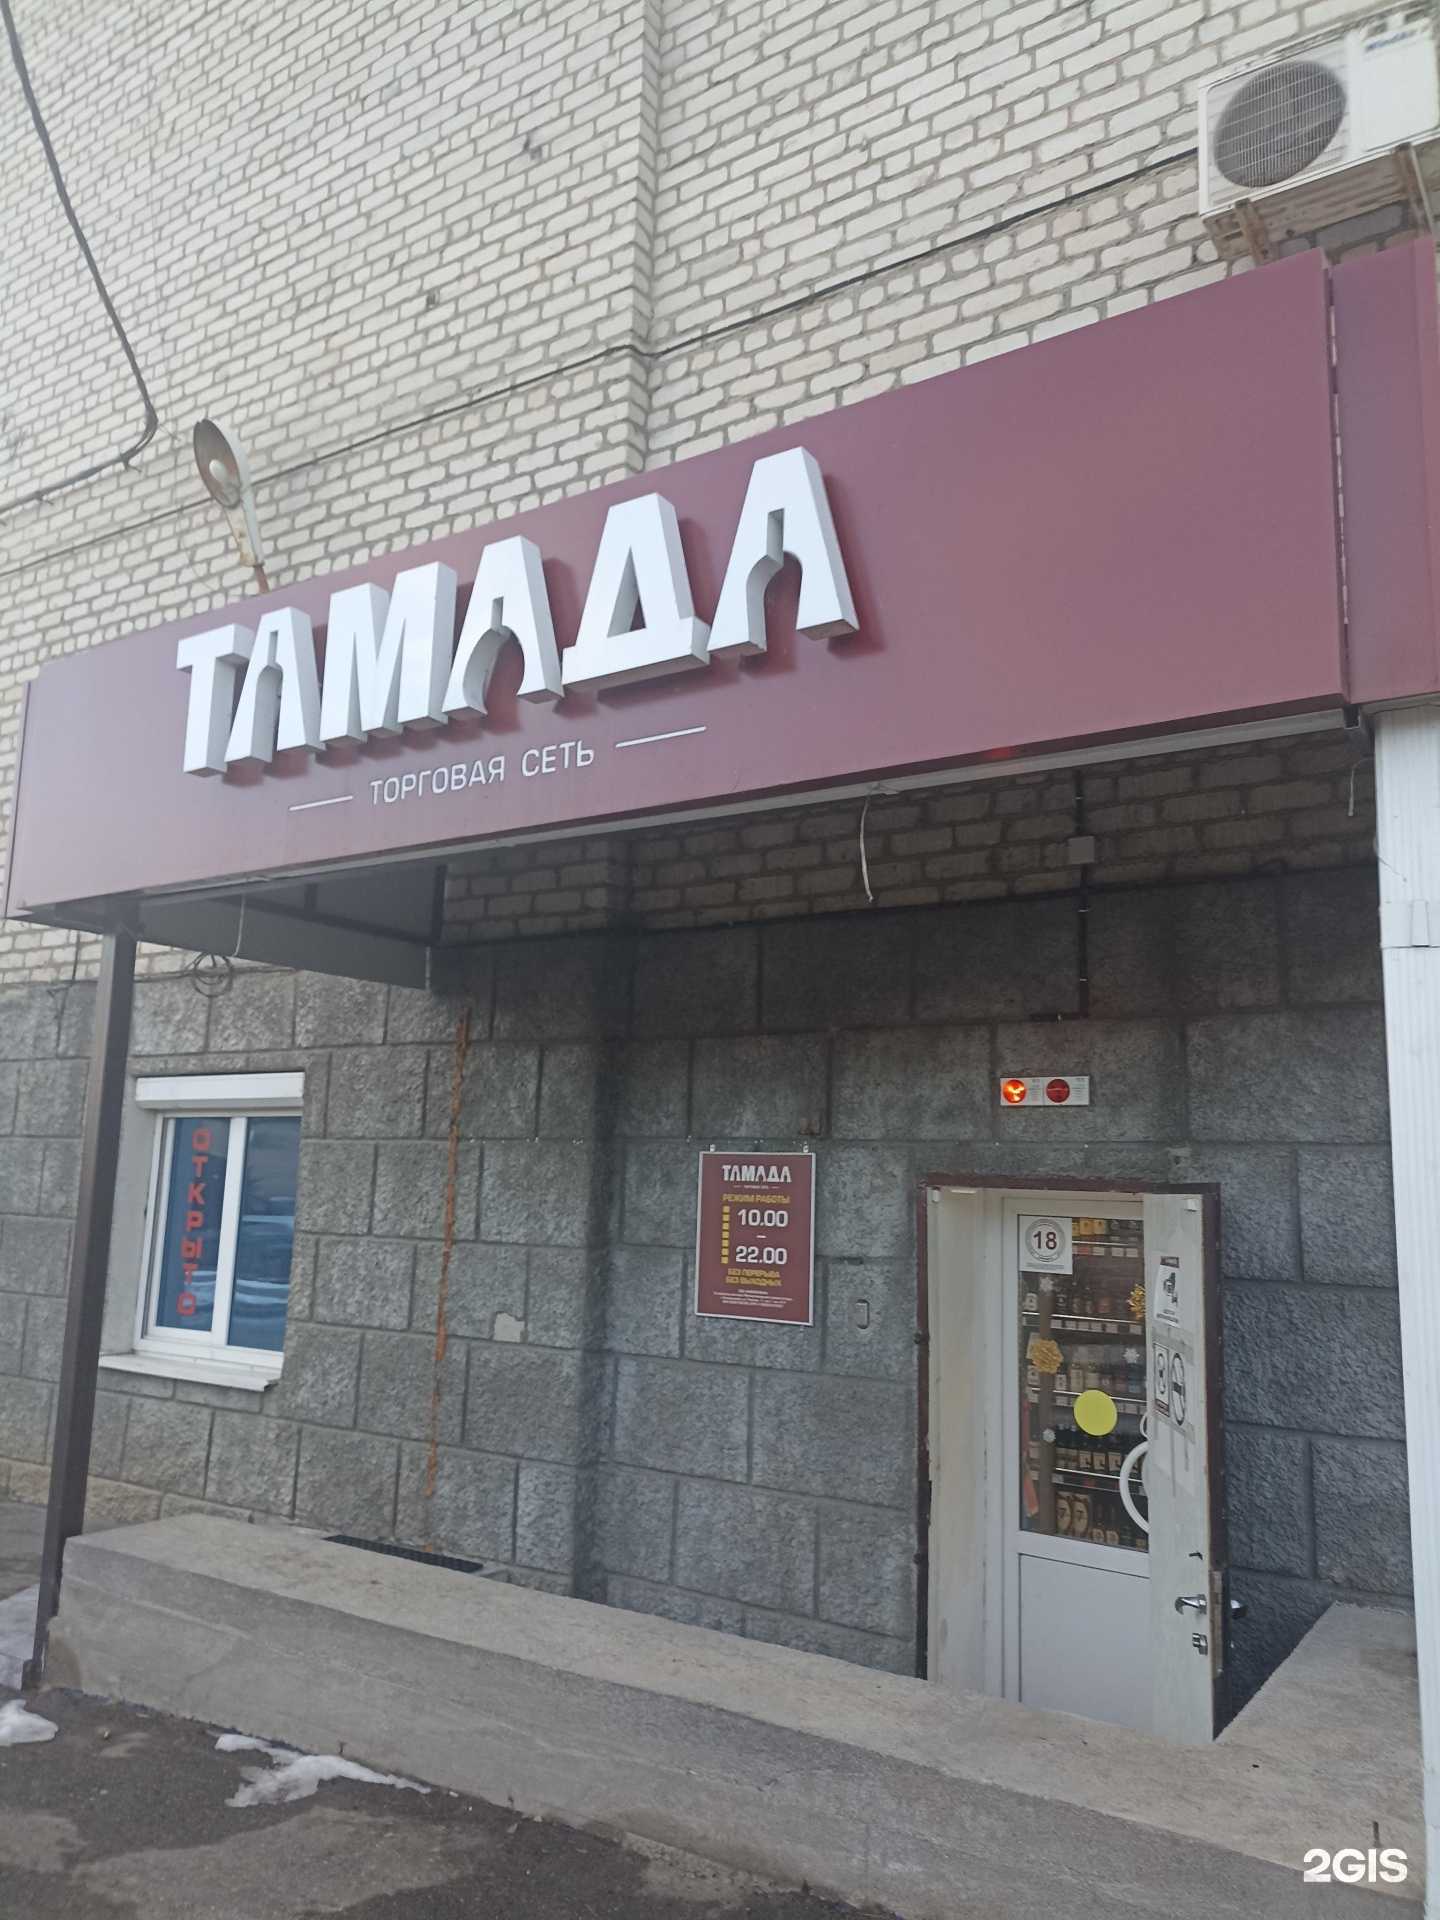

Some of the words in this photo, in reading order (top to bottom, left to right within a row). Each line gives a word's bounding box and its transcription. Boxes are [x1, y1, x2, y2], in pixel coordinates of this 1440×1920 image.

[177, 445, 859, 777] ТАМАДА
[369, 755, 506, 805] ТОРГОВАЯ
[520, 739, 595, 779] СЕТЬ
[722, 1165, 792, 1183] ТАМАДА
[722, 1193, 755, 1203] РЕЖИМ
[756, 1194, 791, 1204] РАБОТЫ
[177, 1129, 212, 1316] ОТКРЫТО
[738, 1209, 788, 1227] 10.00
[1033, 1231, 1057, 1250] 18
[736, 1246, 787, 1265] 22.00
